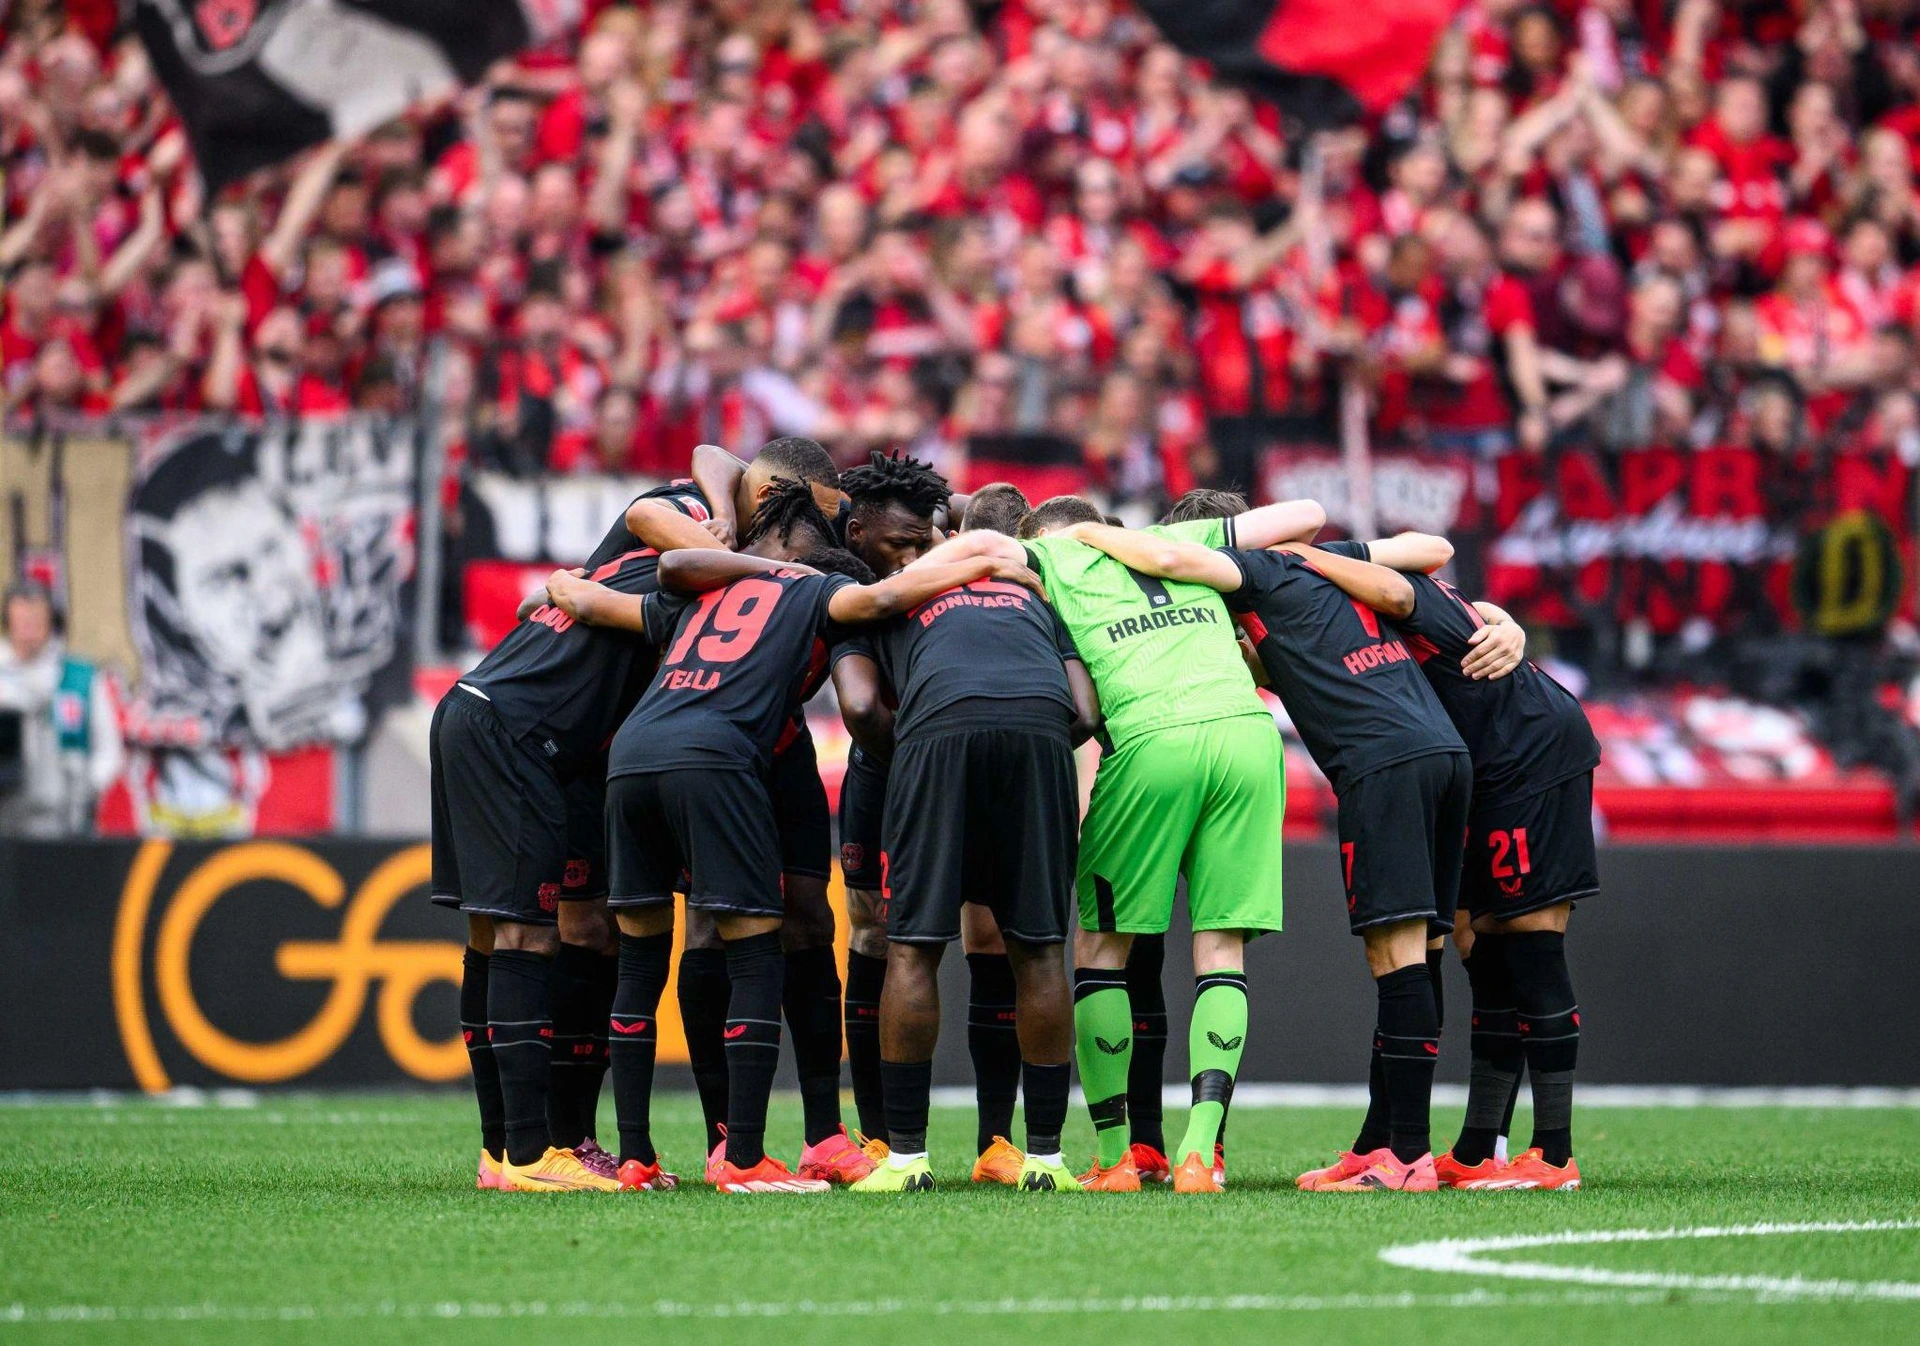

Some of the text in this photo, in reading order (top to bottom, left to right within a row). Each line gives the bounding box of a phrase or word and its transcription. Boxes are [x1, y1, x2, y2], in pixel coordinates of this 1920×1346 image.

[665, 578, 783, 666] 19
[919, 594, 1027, 628] BONIFACE
[1106, 606, 1218, 644] HRADECKY
[1488, 828, 1531, 878] 21
